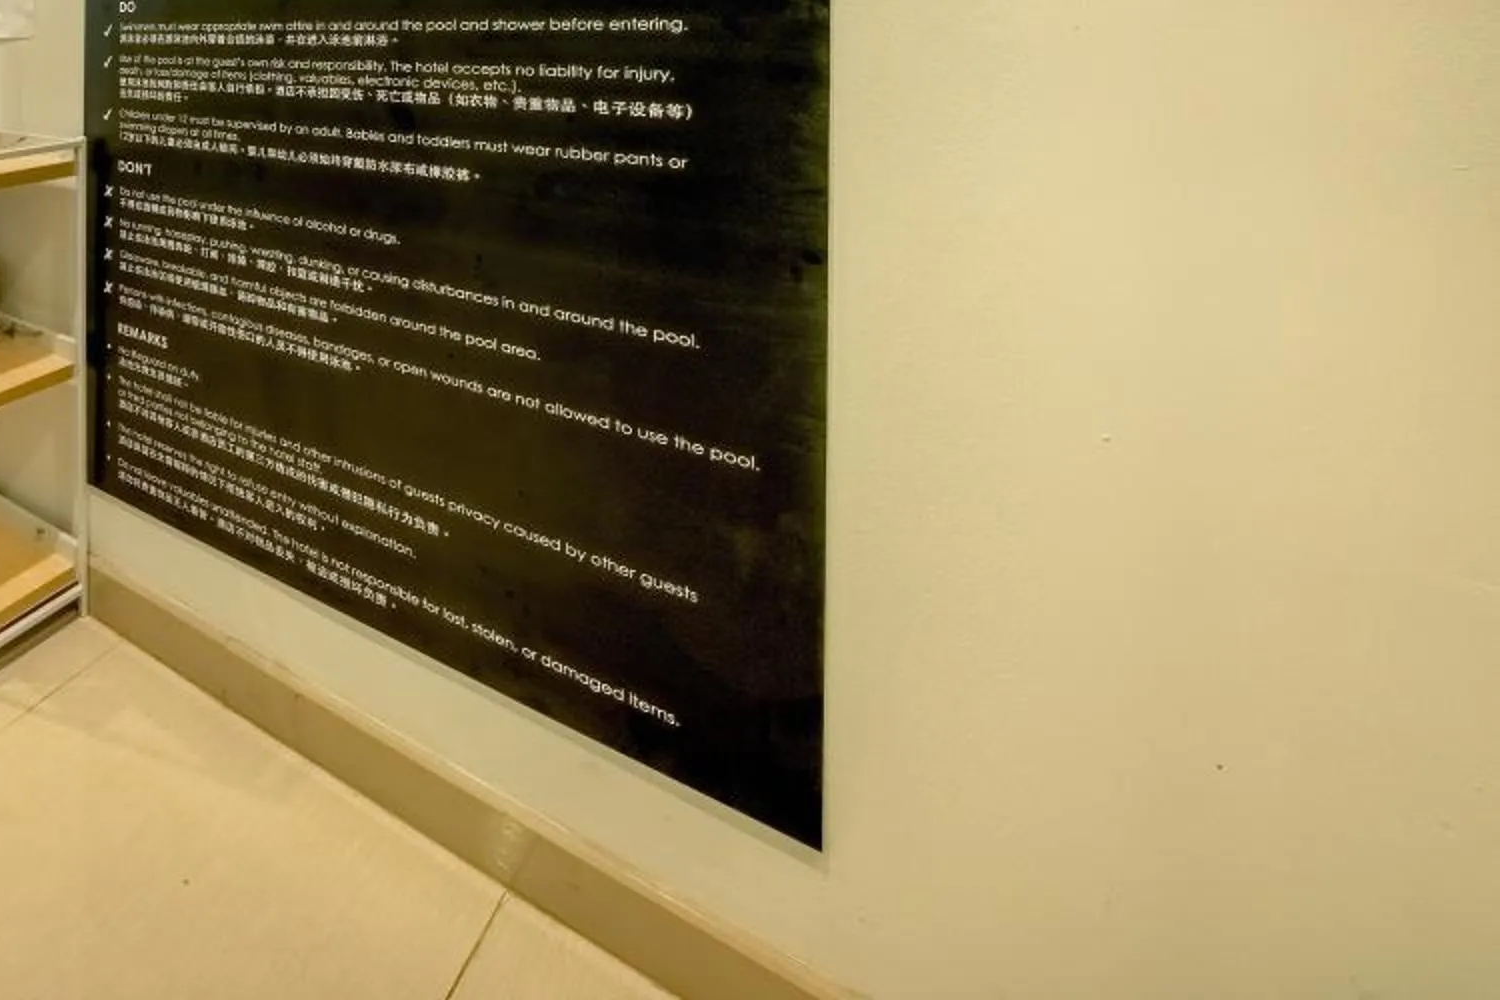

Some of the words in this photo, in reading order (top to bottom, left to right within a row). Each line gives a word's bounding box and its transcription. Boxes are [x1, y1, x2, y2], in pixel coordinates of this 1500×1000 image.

[119, 1, 137, 13] DO
[328, 19, 350, 31] and
[354, 19, 398, 31] around
[402, 19, 422, 31] the
[425, 18, 458, 34] pool
[460, 18, 488, 31] and
[492, 18, 545, 31] shower
[550, 17, 604, 31] before
[608, 17, 688, 34] entering.
[288, 58, 310, 69] and
[391, 60, 413, 73] The
[416, 61, 449, 74] hotel
[452, 62, 511, 79] accepts
[515, 66, 534, 77] no
[538, 63, 592, 82] liability
[598, 64, 618, 79] for
[358, 75, 420, 88] electronic
[296, 126, 309, 135] an
[346, 128, 384, 142] Babies
[388, 133, 414, 145] and
[417, 134, 471, 150] toddlers
[474, 140, 508, 153] must
[512, 144, 550, 157] wear
[554, 146, 608, 162] rubber
[612, 152, 663, 167] pants
[668, 157, 689, 169] or
[292, 216, 303, 228] of
[306, 218, 347, 236] alcohol
[350, 228, 361, 238] or
[363, 227, 400, 245] drugs.
[348, 267, 360, 277] or
[362, 269, 410, 289] causing
[412, 277, 499, 306] disturbances
[502, 295, 514, 309] in
[519, 302, 550, 317] and
[553, 309, 615, 331] around
[620, 319, 648, 337] the
[653, 329, 700, 349] pool.
[117, 322, 169, 349] REMARKS
[310, 296, 328, 308] are
[330, 298, 387, 322] forbidden
[390, 315, 436, 335] around
[440, 324, 462, 341] the
[464, 334, 497, 350] pool
[500, 343, 541, 361] area.
[378, 356, 392, 368] or
[394, 360, 427, 376] open
[430, 369, 484, 393] wounds
[486, 386, 512, 401] are
[516, 394, 540, 410] not
[544, 401, 610, 429] allowed
[614, 417, 633, 435] to
[638, 427, 668, 445] use
[674, 433, 704, 454] the
[710, 447, 760, 471] pool.
[388, 478, 402, 491] of
[404, 484, 445, 507] guests
[448, 501, 500, 530] privacy
[503, 522, 561, 550] caused
[565, 542, 586, 563] by
[590, 555, 636, 579] other
[640, 573, 698, 602] guests
[352, 567, 420, 605] responsible
[422, 597, 440, 616] for
[522, 647, 536, 661] or
[540, 653, 626, 700] damaged
[628, 691, 680, 728] items.
